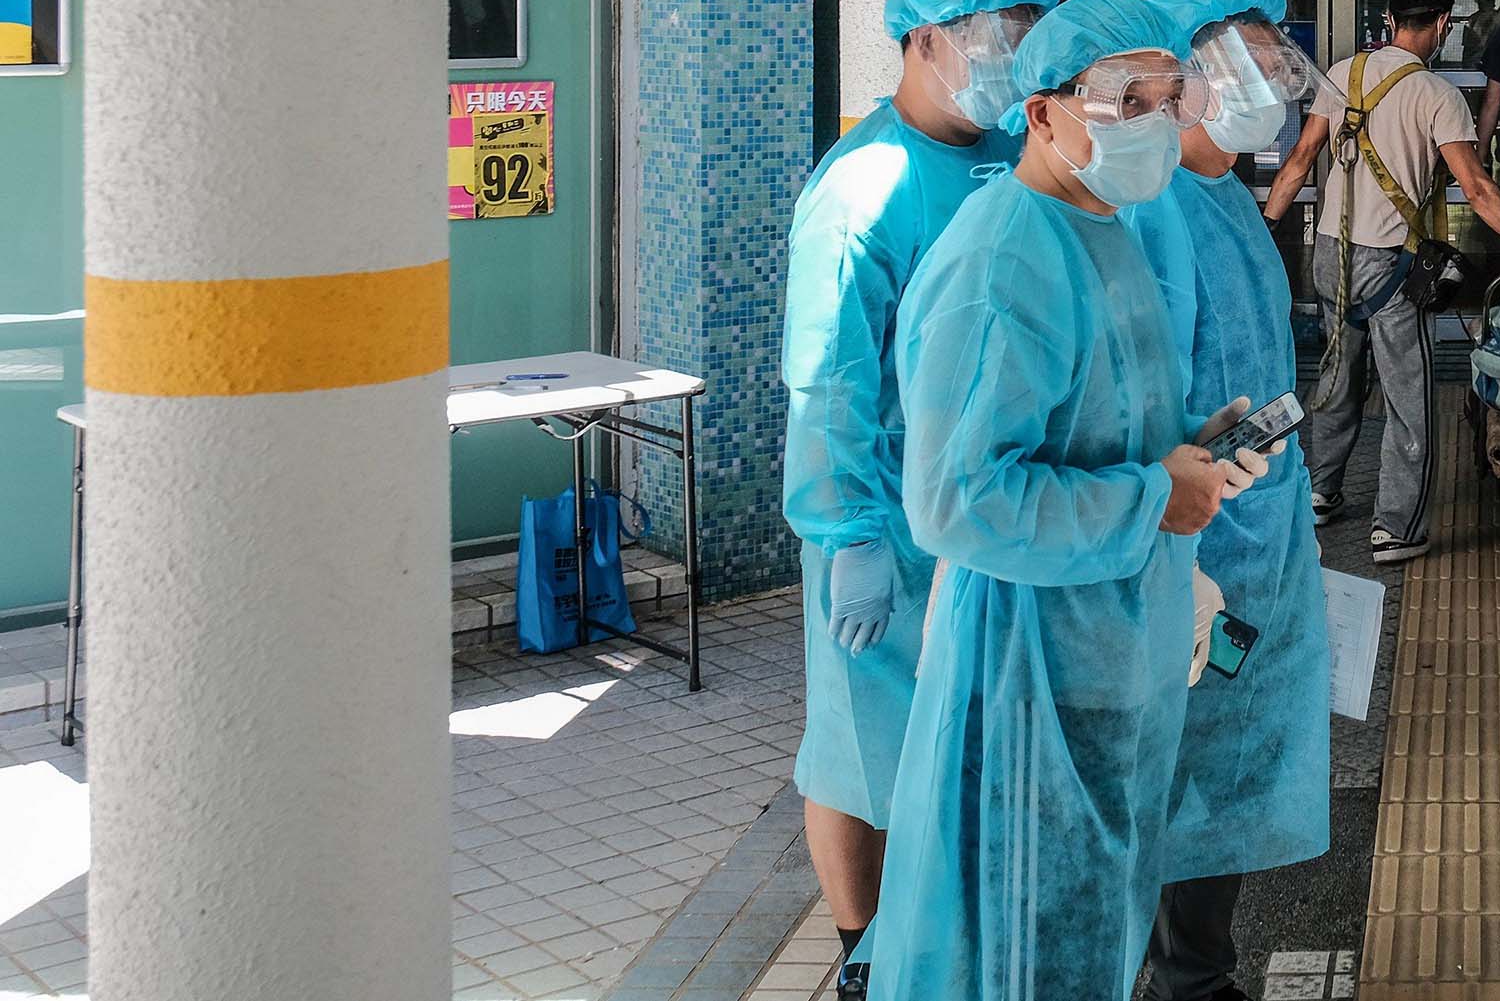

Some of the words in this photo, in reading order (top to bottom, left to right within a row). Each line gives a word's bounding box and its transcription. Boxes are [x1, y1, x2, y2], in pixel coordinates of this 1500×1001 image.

[466, 90, 547, 113] 只限今天
[482, 154, 532, 203] 92
